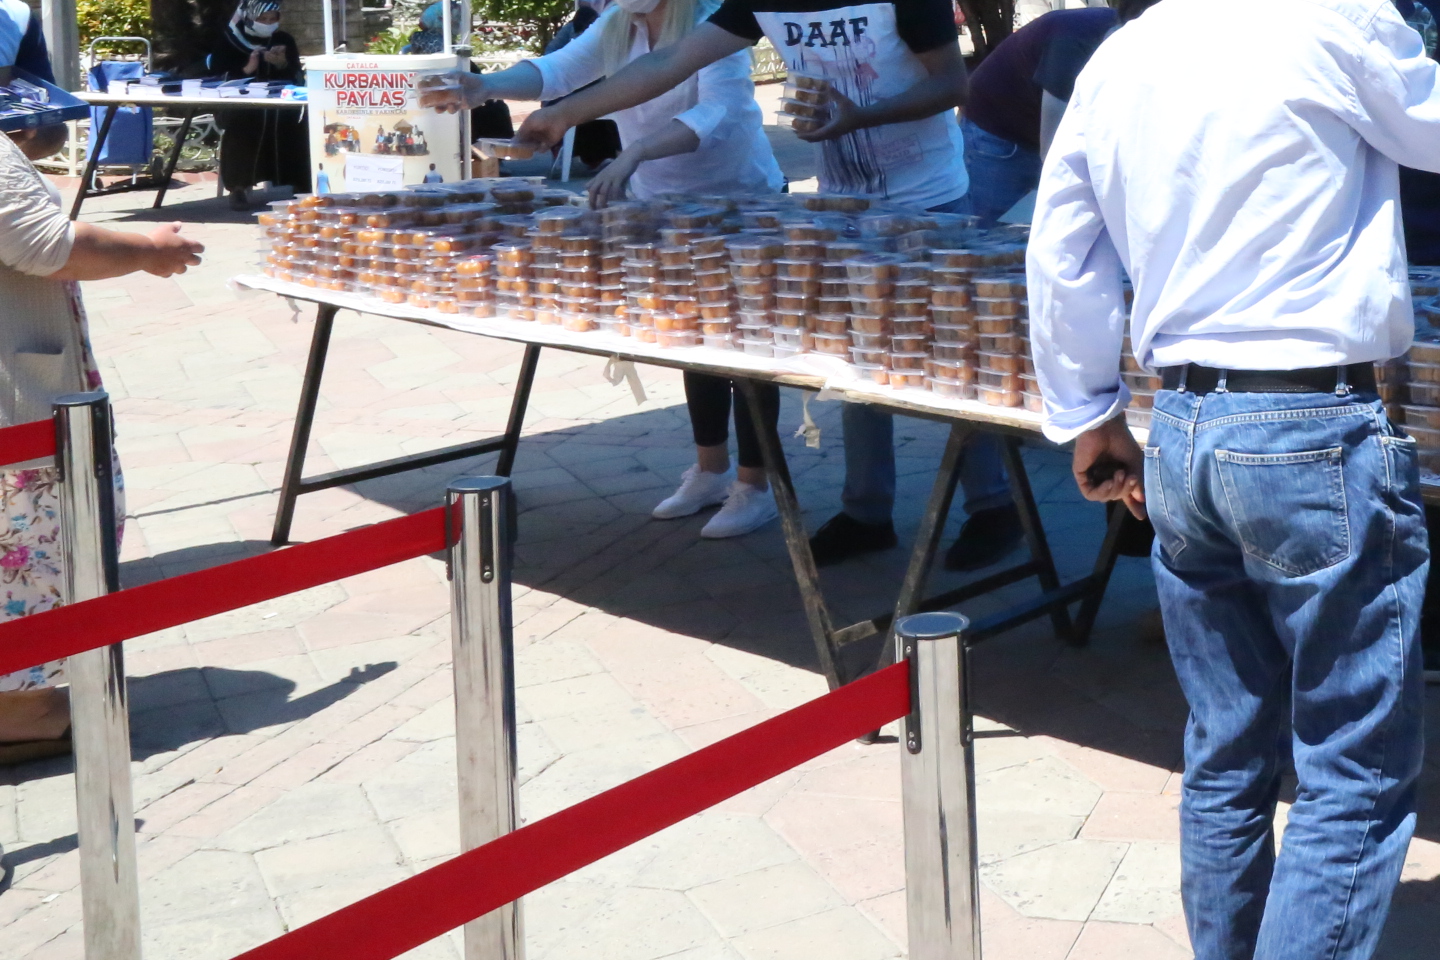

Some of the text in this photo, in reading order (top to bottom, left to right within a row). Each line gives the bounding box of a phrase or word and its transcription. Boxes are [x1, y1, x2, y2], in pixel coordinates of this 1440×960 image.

[783, 16, 868, 48] DAAF
[324, 72, 417, 88] KURBANIN
[337, 91, 405, 108] PAYLAŞ
